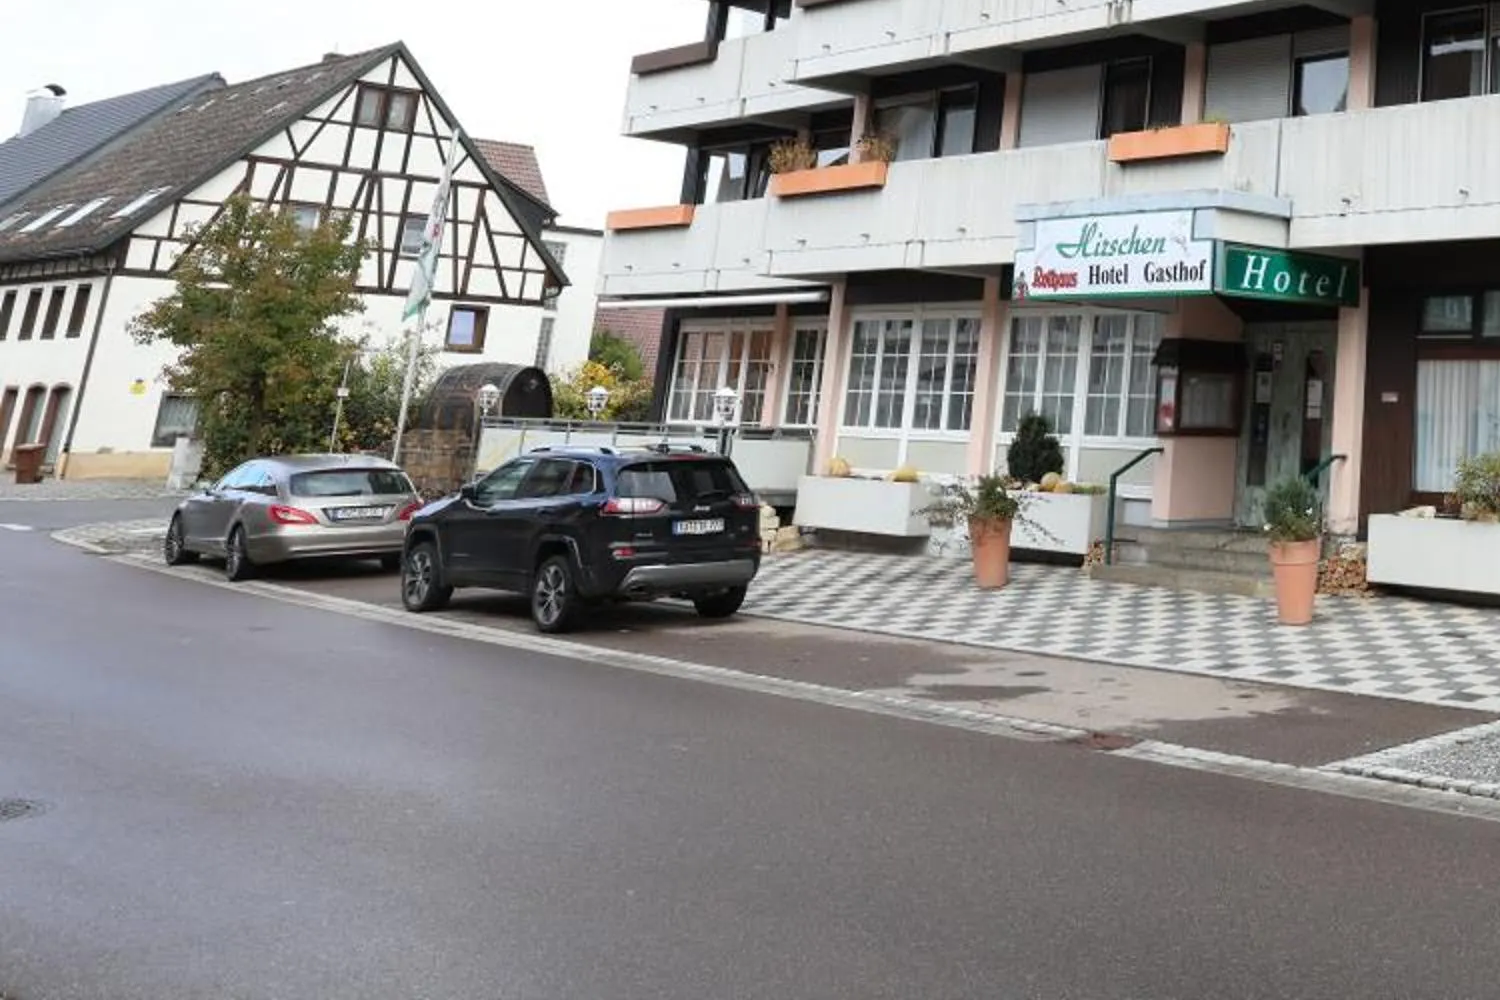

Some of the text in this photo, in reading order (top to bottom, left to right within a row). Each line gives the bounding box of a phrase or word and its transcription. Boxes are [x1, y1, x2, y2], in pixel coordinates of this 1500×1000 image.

[1056, 221, 1166, 259] Hirschen
[1088, 259, 1207, 286] Hotel Gasthof
[1240, 254, 1348, 298] Hotel
